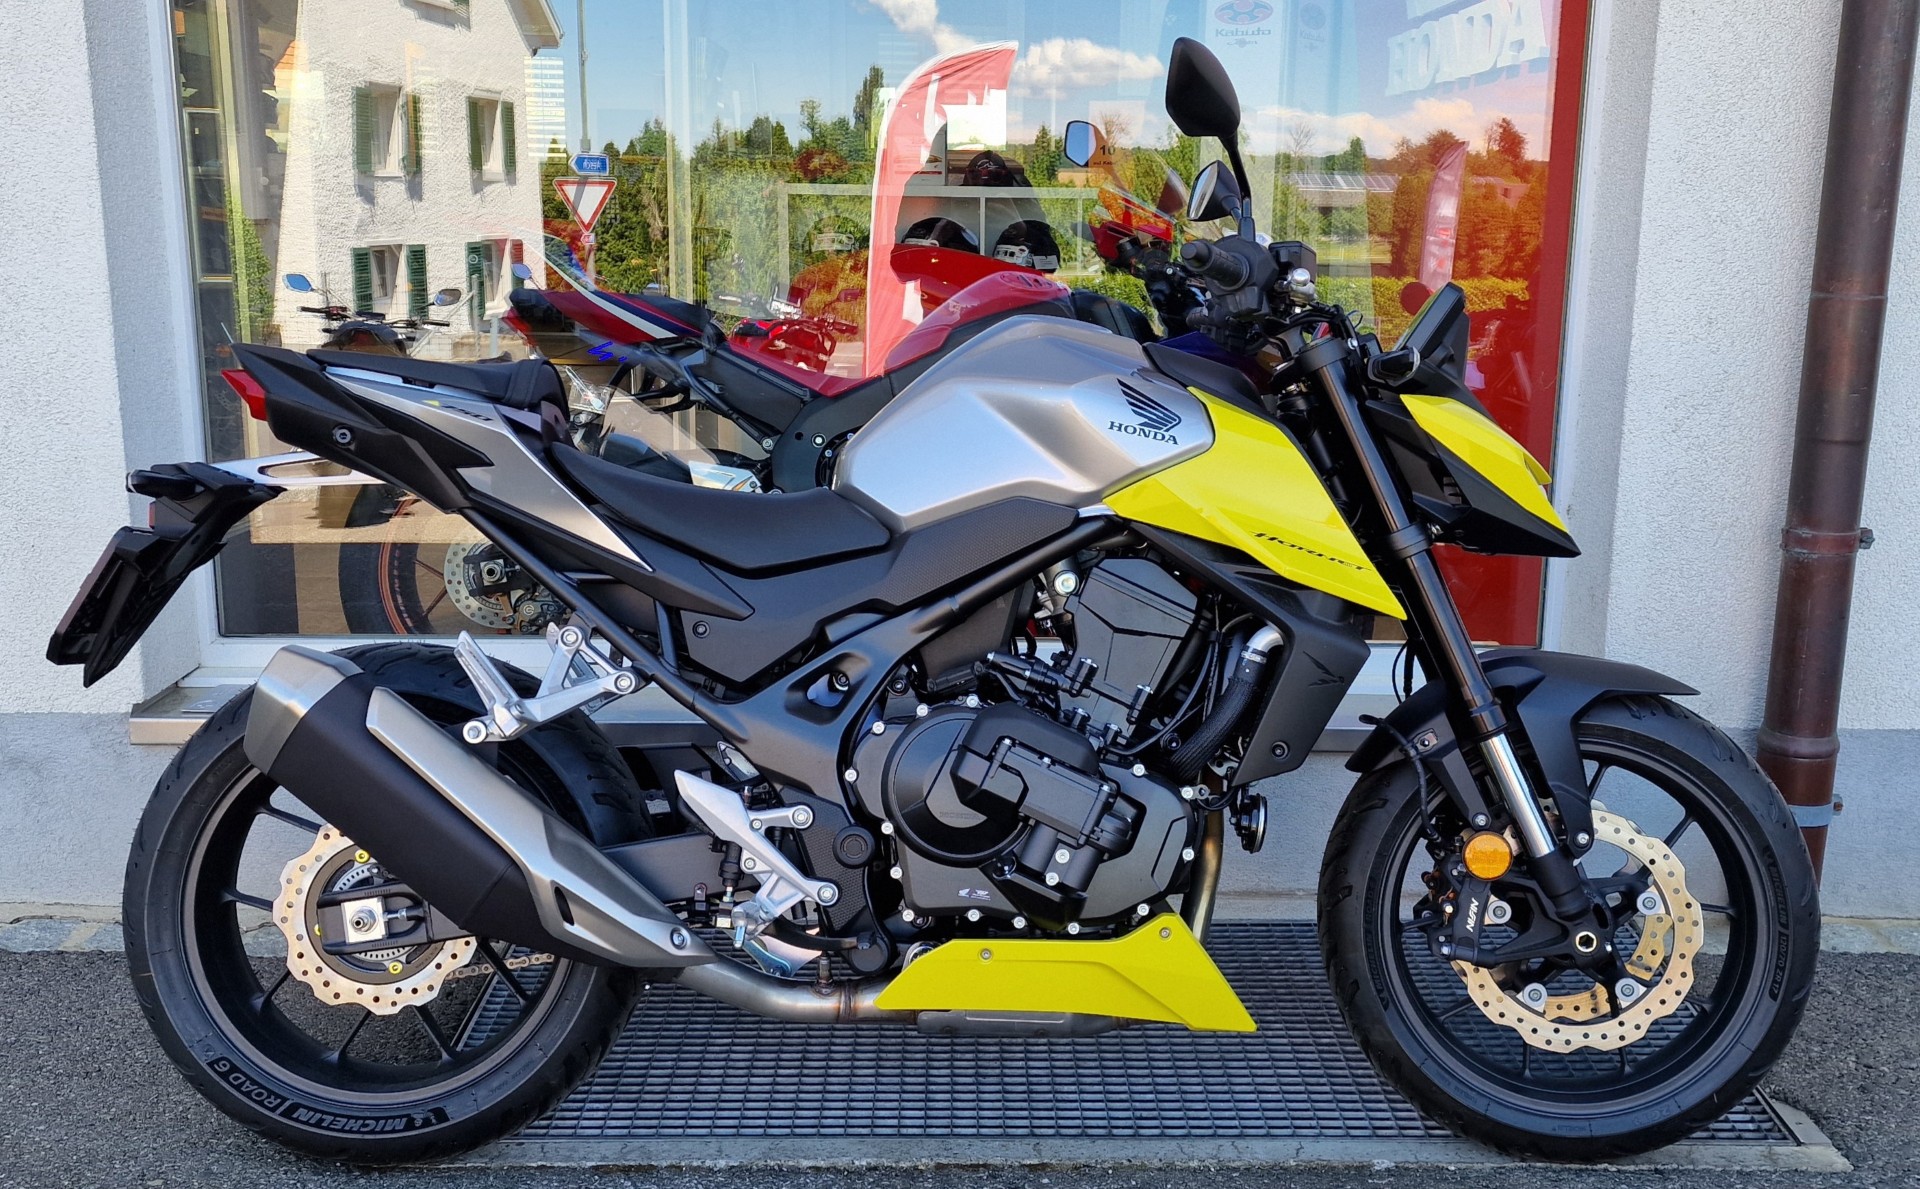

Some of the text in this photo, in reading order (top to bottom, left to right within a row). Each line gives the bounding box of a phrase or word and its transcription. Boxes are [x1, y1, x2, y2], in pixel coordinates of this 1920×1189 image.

[1215, 27, 1272, 37] Kabuto
[1385, 0, 1551, 97] HONDA
[1108, 420, 1179, 446] HONDA
[1768, 866, 1788, 925] MICHELIN
[1776, 935, 1788, 967] 120/70
[213, 1060, 408, 1132] MICHELIN ROAD 6
